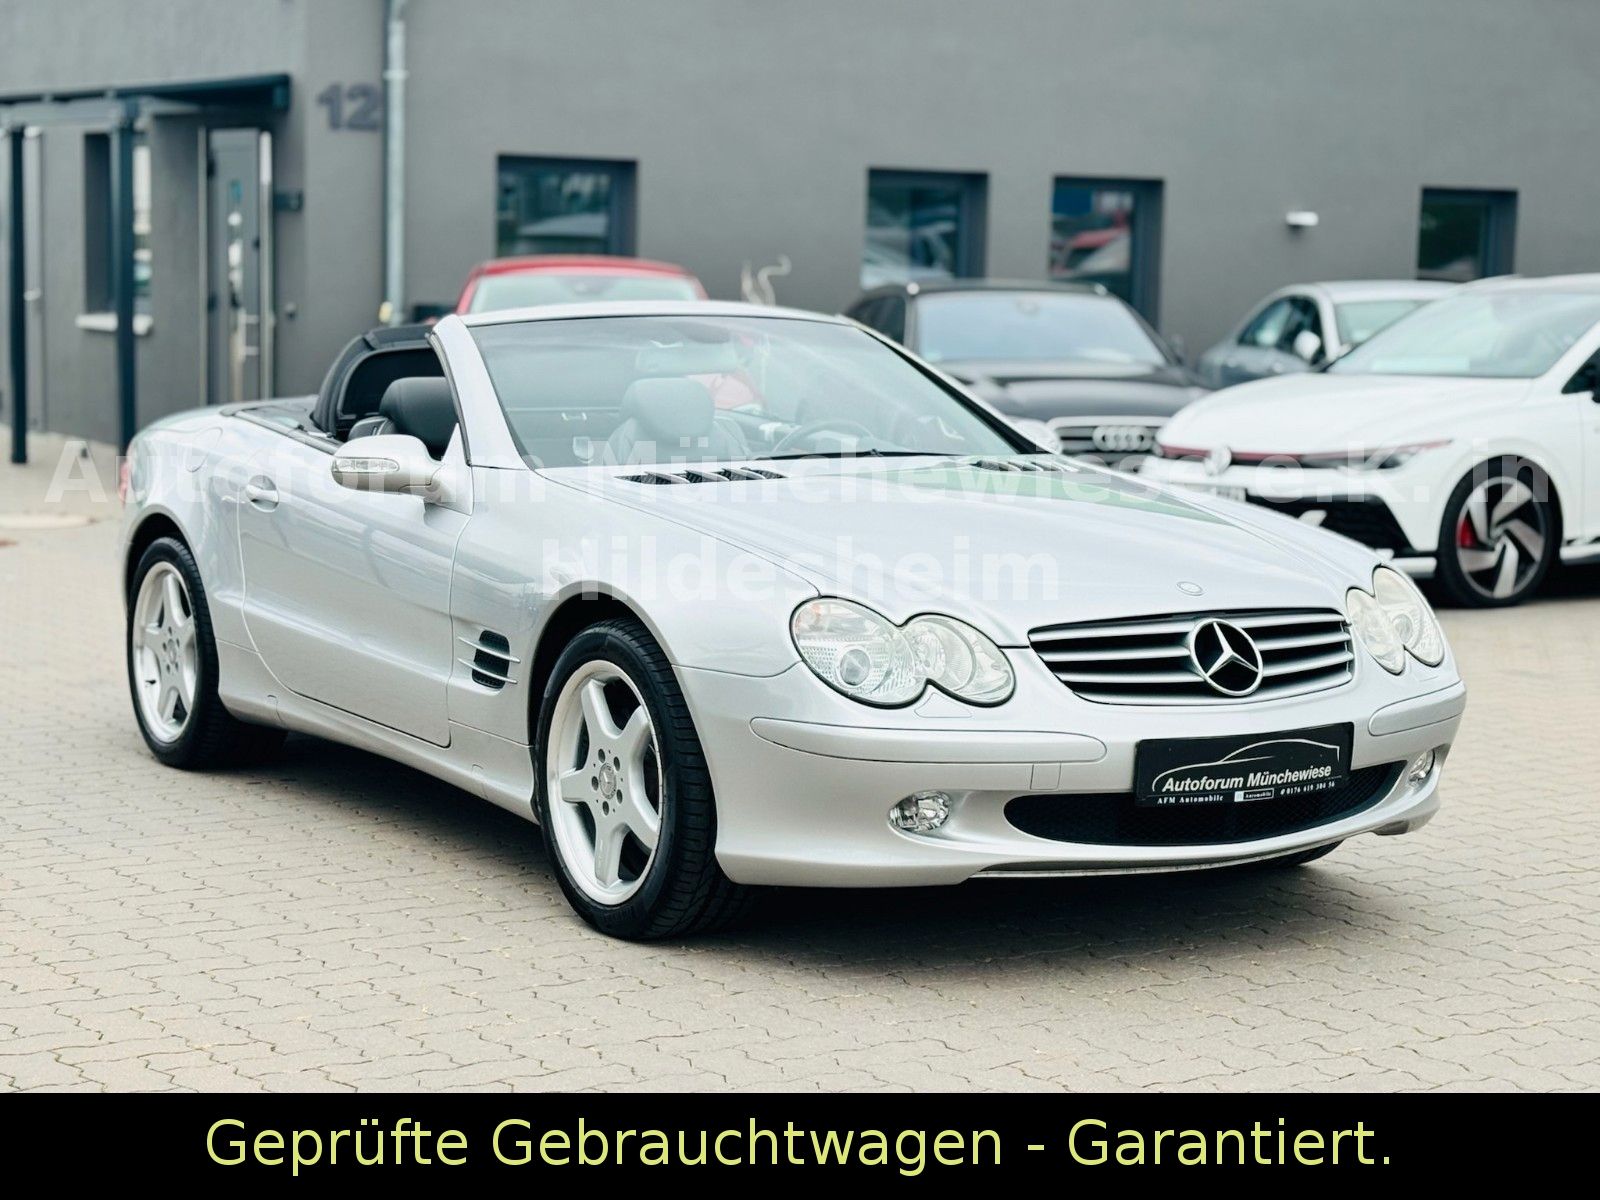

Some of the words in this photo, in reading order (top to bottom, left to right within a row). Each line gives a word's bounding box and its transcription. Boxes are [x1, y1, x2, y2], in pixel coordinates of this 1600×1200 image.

[316, 83, 382, 131] 12
[1161, 776, 1244, 792] Autoforum
[1246, 765, 1332, 787] Münchewiese
[1157, 796, 1176, 805] AFM
